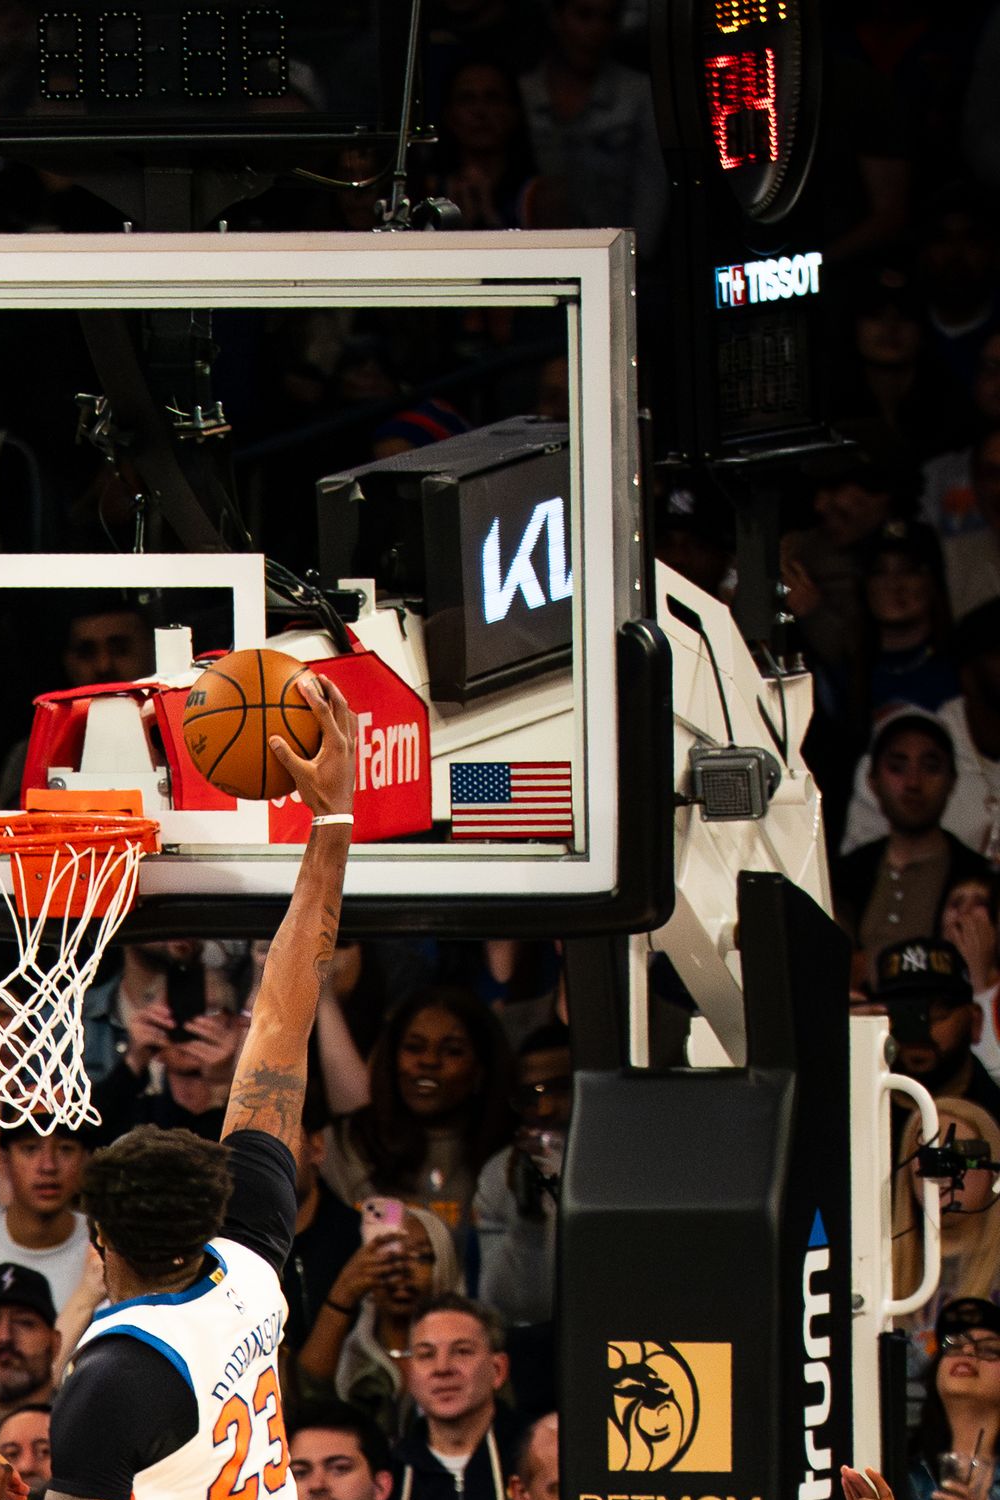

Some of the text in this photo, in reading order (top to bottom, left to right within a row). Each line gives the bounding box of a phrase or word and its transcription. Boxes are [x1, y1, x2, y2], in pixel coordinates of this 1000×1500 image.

[744, 252, 822, 303] TISSOT
[483, 496, 573, 624] KI
[357, 711, 420, 791] Farm
